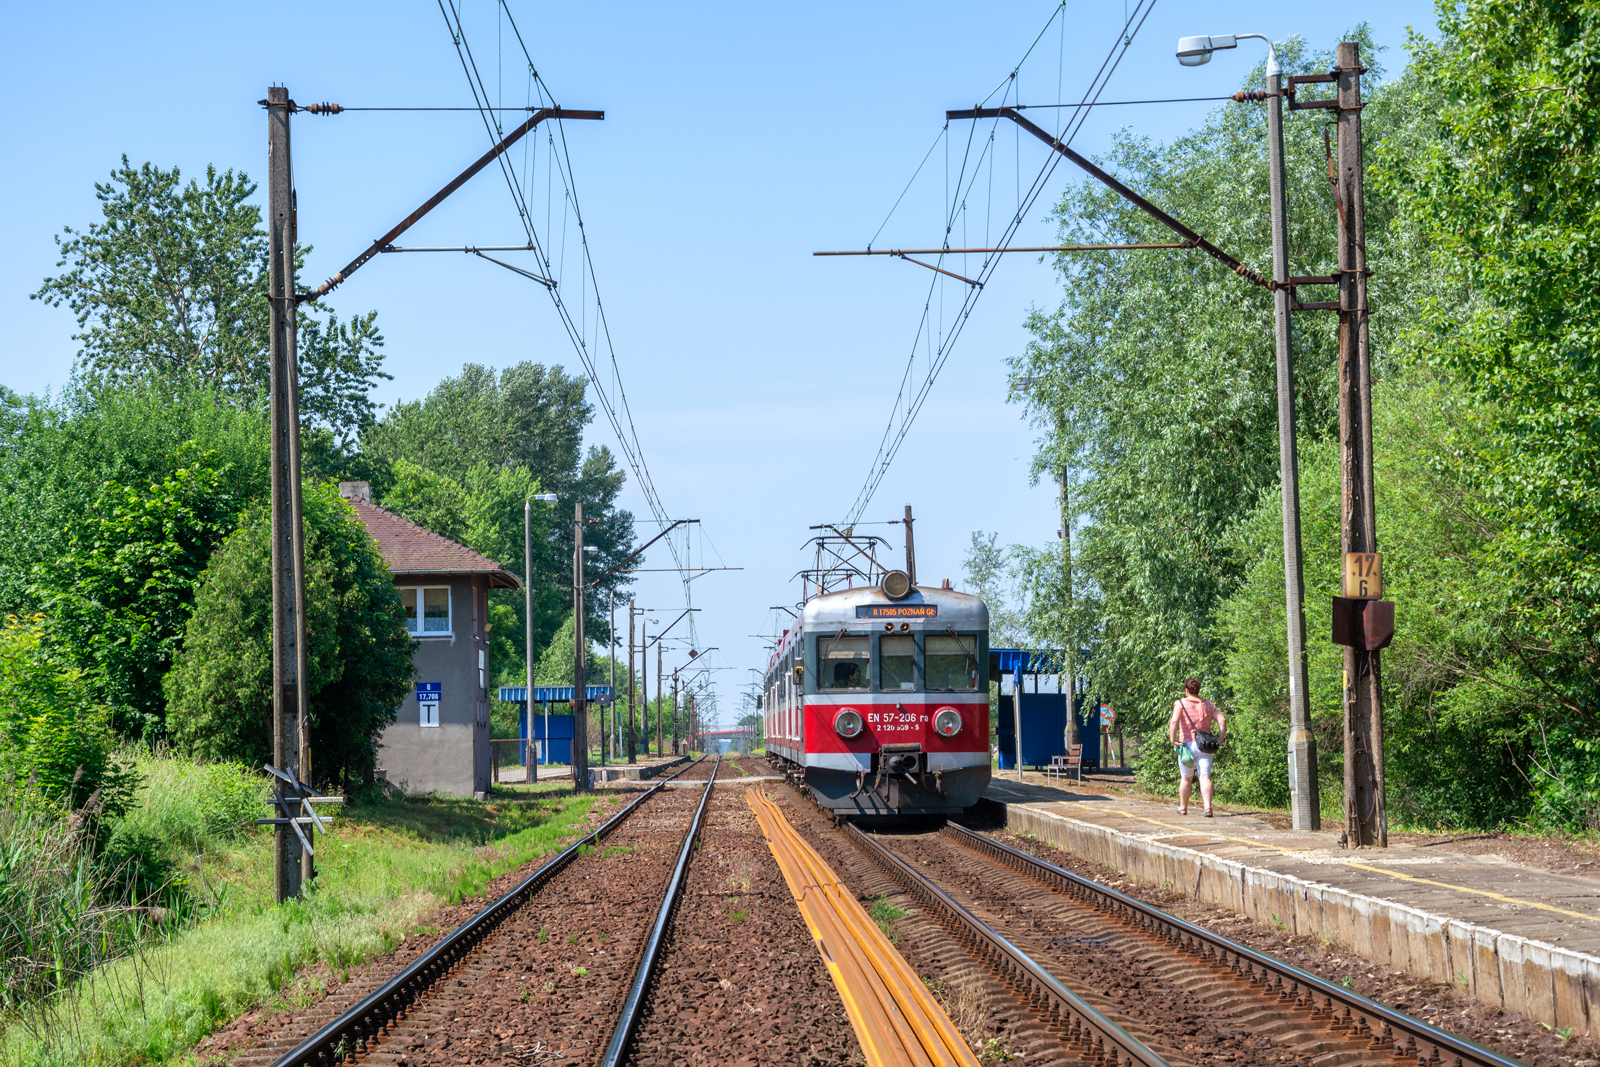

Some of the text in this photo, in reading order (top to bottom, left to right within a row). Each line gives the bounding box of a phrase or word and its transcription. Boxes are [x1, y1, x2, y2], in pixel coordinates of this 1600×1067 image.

[1353, 554, 1376, 577] 17
[1359, 579, 1368, 598] 6
[873, 608, 878, 616] R
[898, 606, 925, 616] POZNAŃ
[422, 704, 436, 724] T
[868, 713, 880, 722] EN
[883, 713, 917, 722] 57-206
